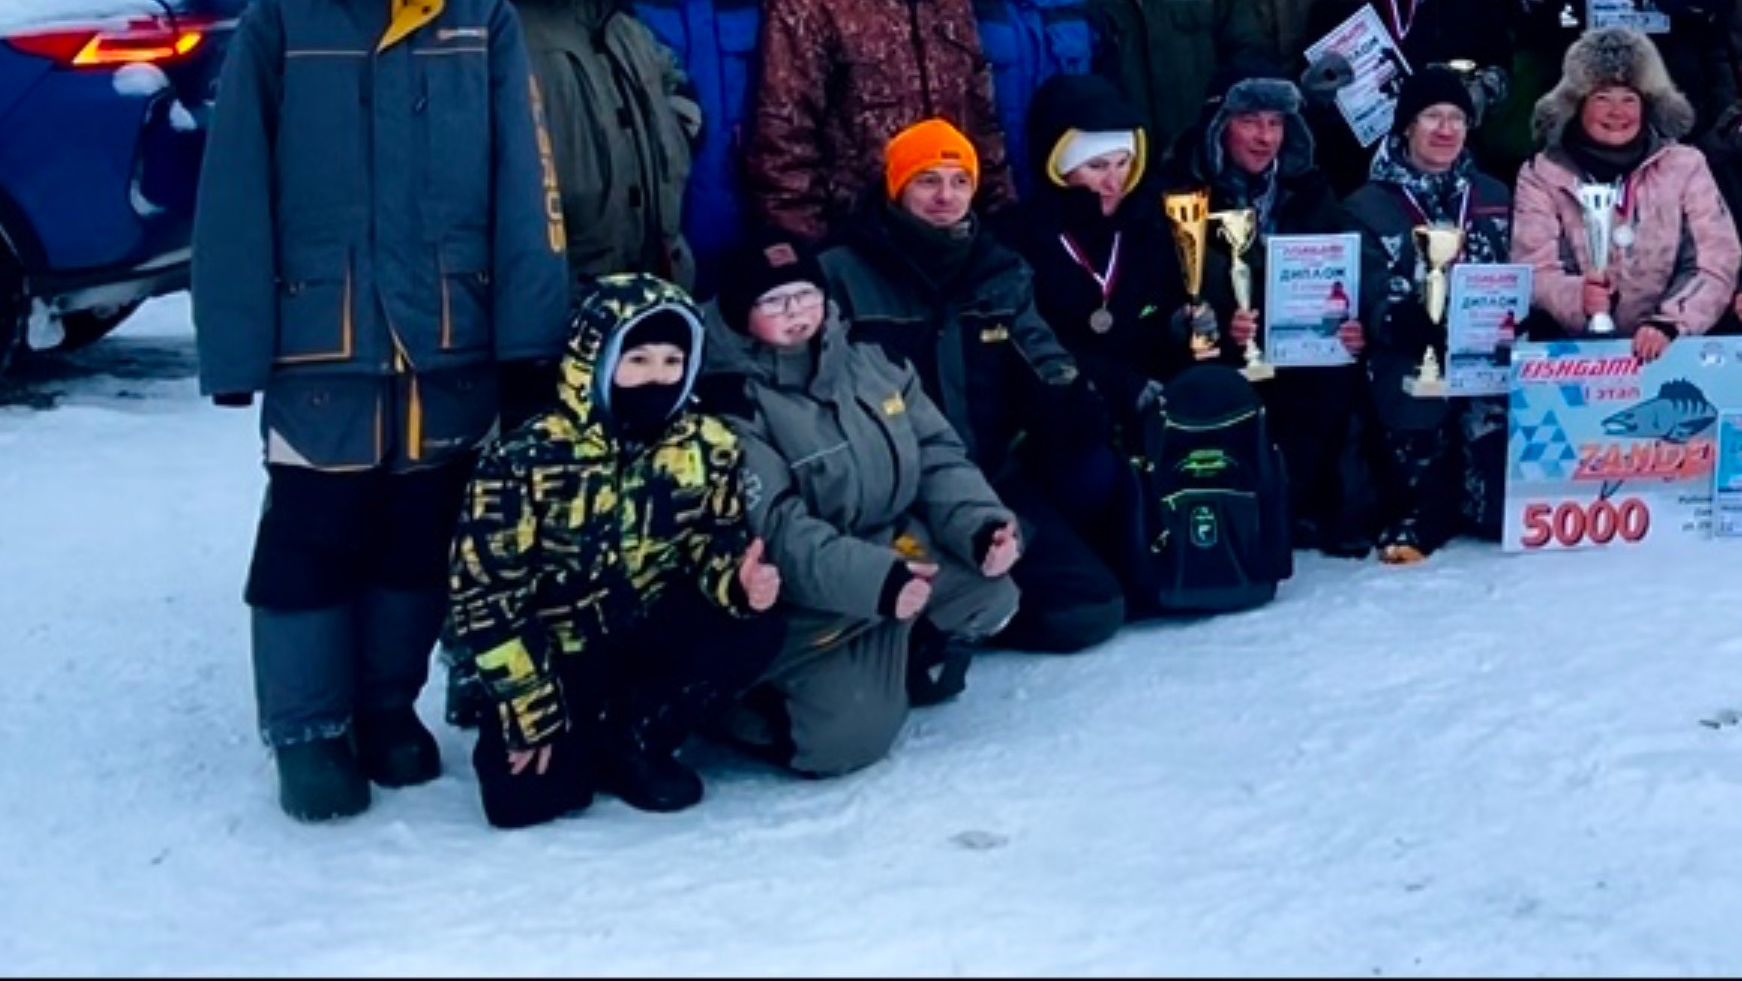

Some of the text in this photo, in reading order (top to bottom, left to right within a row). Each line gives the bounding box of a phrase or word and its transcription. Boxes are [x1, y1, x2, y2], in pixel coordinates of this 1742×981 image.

[1280, 268, 1346, 282] ДИПЛОМ
[1571, 441, 1715, 482] ZANDE
[1520, 497, 1650, 549] 5000
